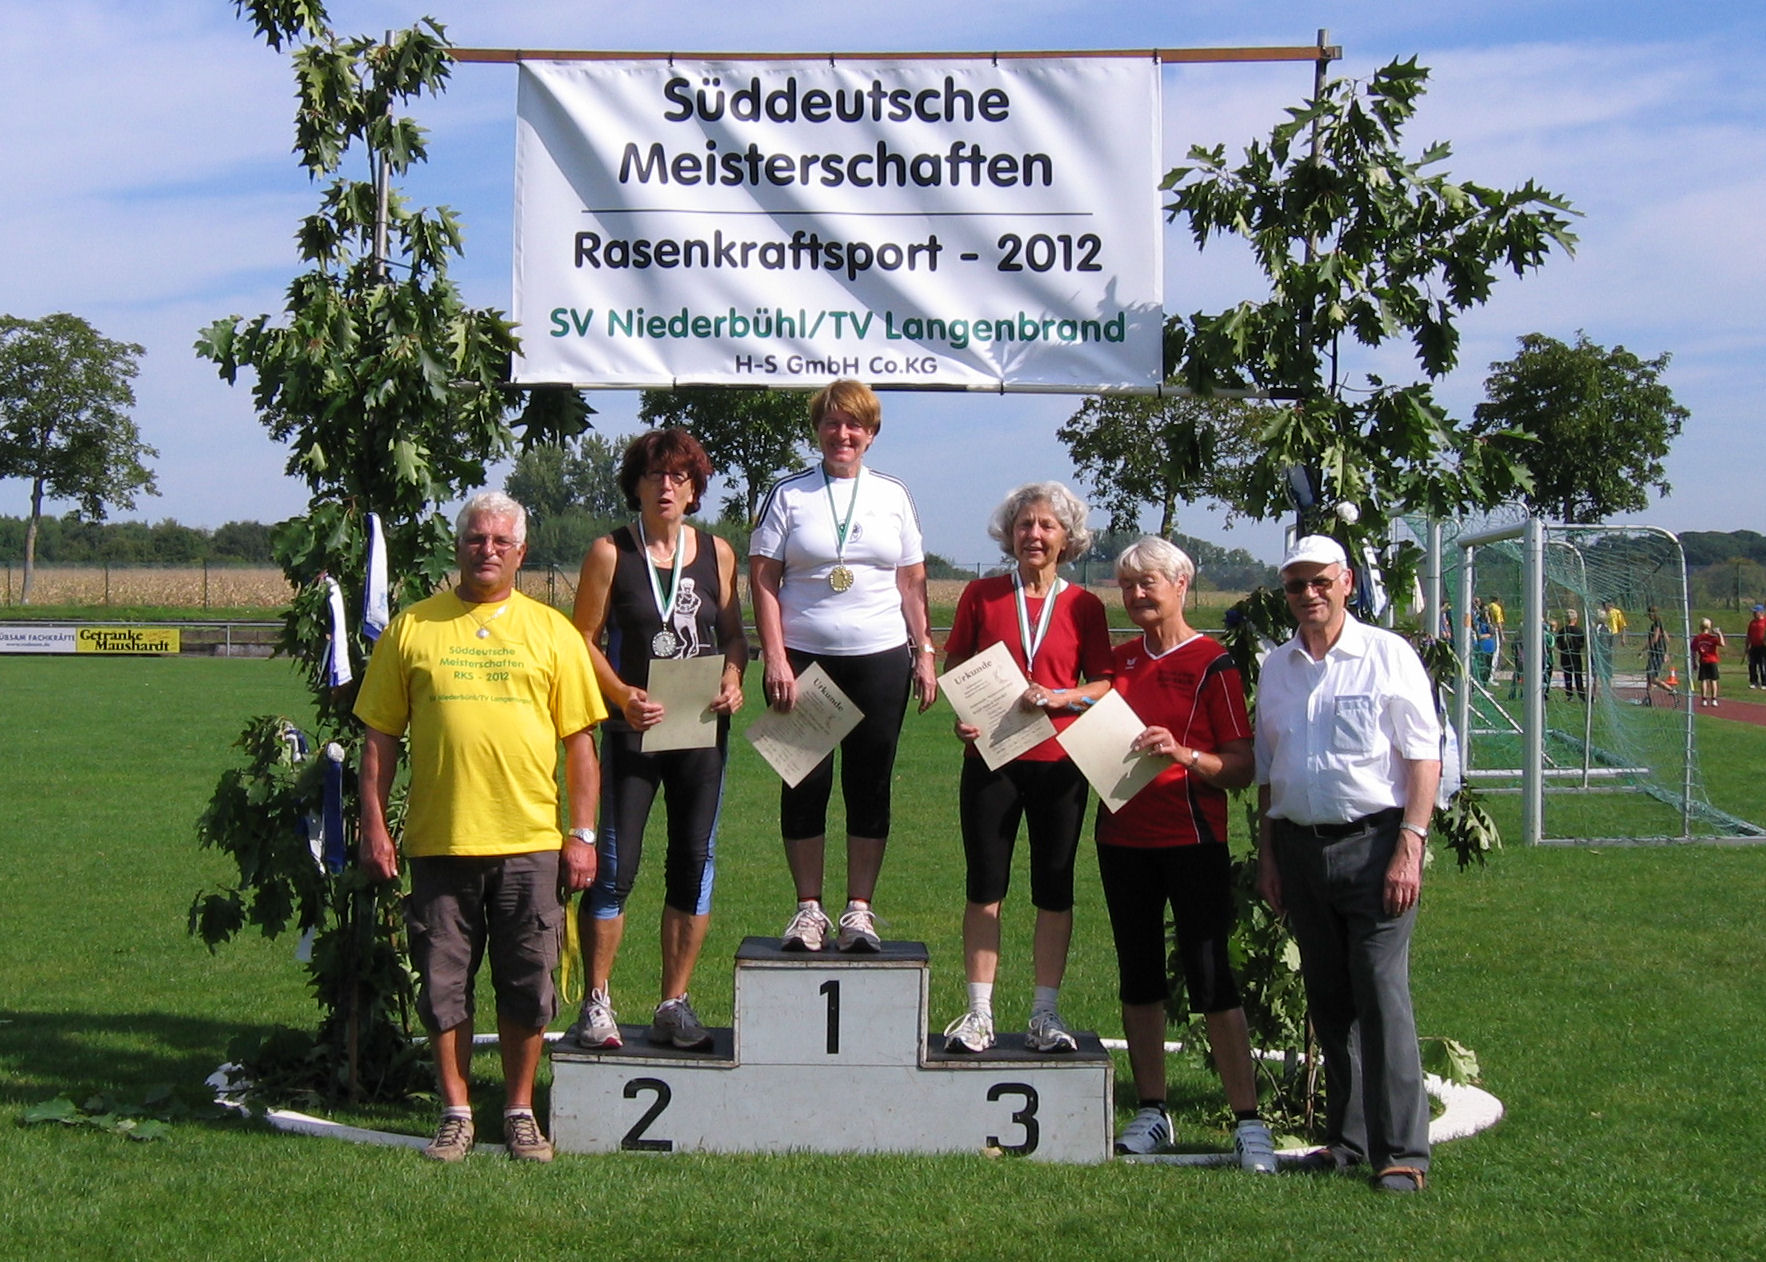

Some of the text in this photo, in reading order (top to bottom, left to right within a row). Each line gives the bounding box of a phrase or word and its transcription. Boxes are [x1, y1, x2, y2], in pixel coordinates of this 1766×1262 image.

[663, 76, 1009, 124] Süddeutsche
[619, 141, 1053, 188] Meisterschaften
[573, 230, 1103, 281] Rasenkraftsport - 2012
[549, 306, 1126, 349] SV Niederbühl/TV Langenbrand
[734, 354, 938, 375] H-S GmbH Co.KG
[95, 639, 169, 651] Maushardt
[440, 658, 524, 668] Meisterschaften
[449, 646, 516, 656] Süddeutsche
[454, 671, 474, 680] RKS
[486, 672, 509, 681] 2012
[953, 659, 993, 686] Urkunde
[813, 678, 845, 713] Urkunde
[819, 979, 841, 1055] 1
[621, 1077, 673, 1152] 2
[986, 1082, 1040, 1157] 3
